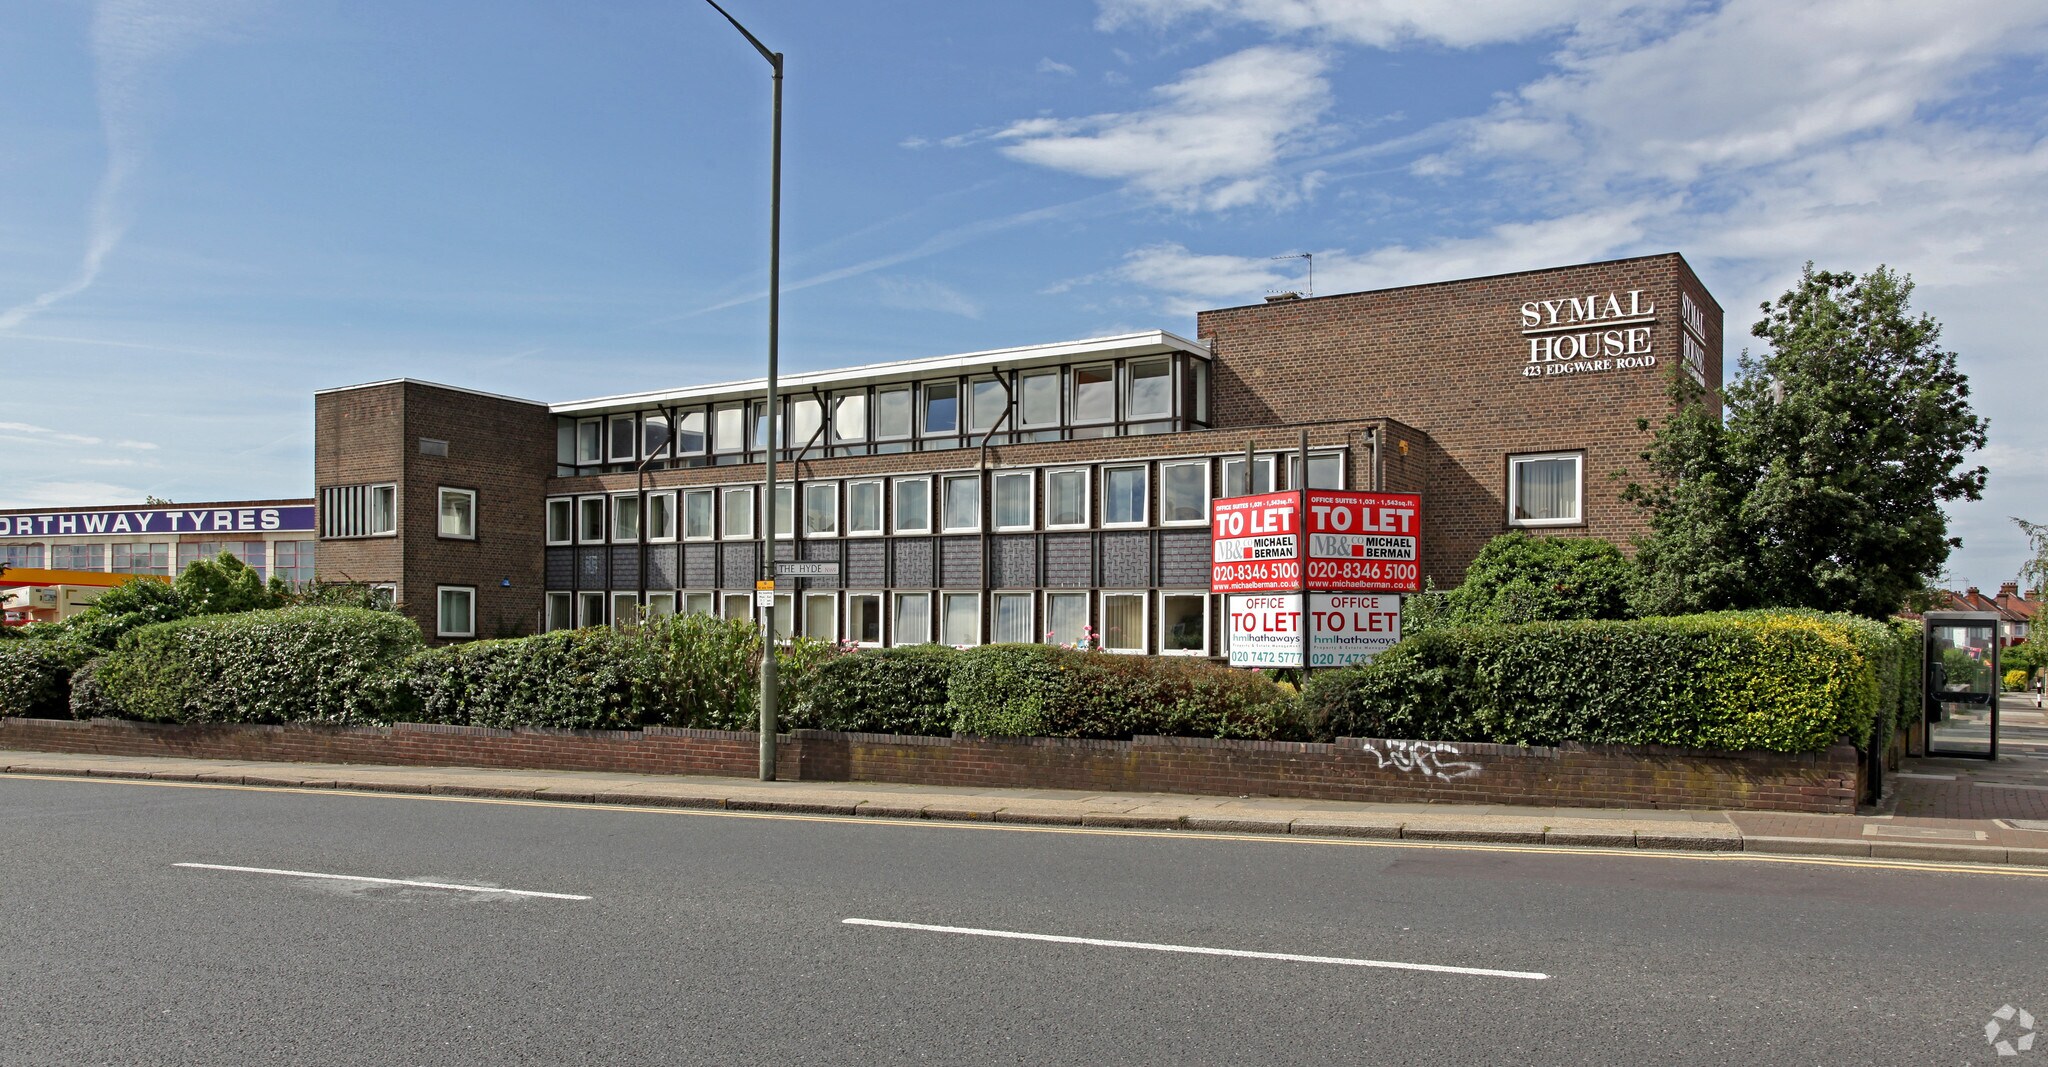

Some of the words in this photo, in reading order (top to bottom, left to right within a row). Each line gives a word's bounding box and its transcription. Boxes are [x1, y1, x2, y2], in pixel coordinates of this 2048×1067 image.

[1521, 289, 1655, 328] SYMAL
[1681, 291, 1705, 340] SYMAL
[1527, 326, 1652, 364] HOUSE
[1522, 365, 1541, 377] 423
[1546, 358, 1612, 375] EDGWARE
[1616, 355, 1656, 369] ROAD
[1311, 496, 1334, 504] OFFICE
[1216, 504, 1232, 512] OFFICE
[166, 509, 281, 531] TYRES
[1216, 511, 1244, 537] TO
[1250, 507, 1294, 534] LET
[1311, 505, 1353, 531] TO
[1362, 507, 1415, 533] LET
[1254, 536, 1293, 548] MICHAEL
[1366, 537, 1412, 548] MICHAEL
[1254, 547, 1293, 558] BERMAN
[1366, 548, 1411, 558] BERMAN
[779, 564, 795, 573] THE
[799, 564, 822, 573] HYDE
[1214, 563, 1268, 581] 020-8346
[1271, 561, 1299, 578] 5100
[1308, 561, 1381, 579] 020-8346
[1385, 563, 1417, 580] 5100
[1213, 580, 1300, 590] www.michaelberman.co.uk
[1308, 580, 1416, 590] www.michaelberman.co.uk
[1246, 597, 1285, 609] OFFICE
[1331, 597, 1379, 609] OFFICE
[1231, 612, 1256, 632] TO
[1263, 612, 1301, 632] LET
[1311, 611, 1346, 632] TO
[1354, 612, 1398, 632] LET
[1231, 651, 1249, 662] 020
[1251, 651, 1275, 663] 7472
[1278, 652, 1302, 663] 5777
[1312, 653, 1334, 665] 020
